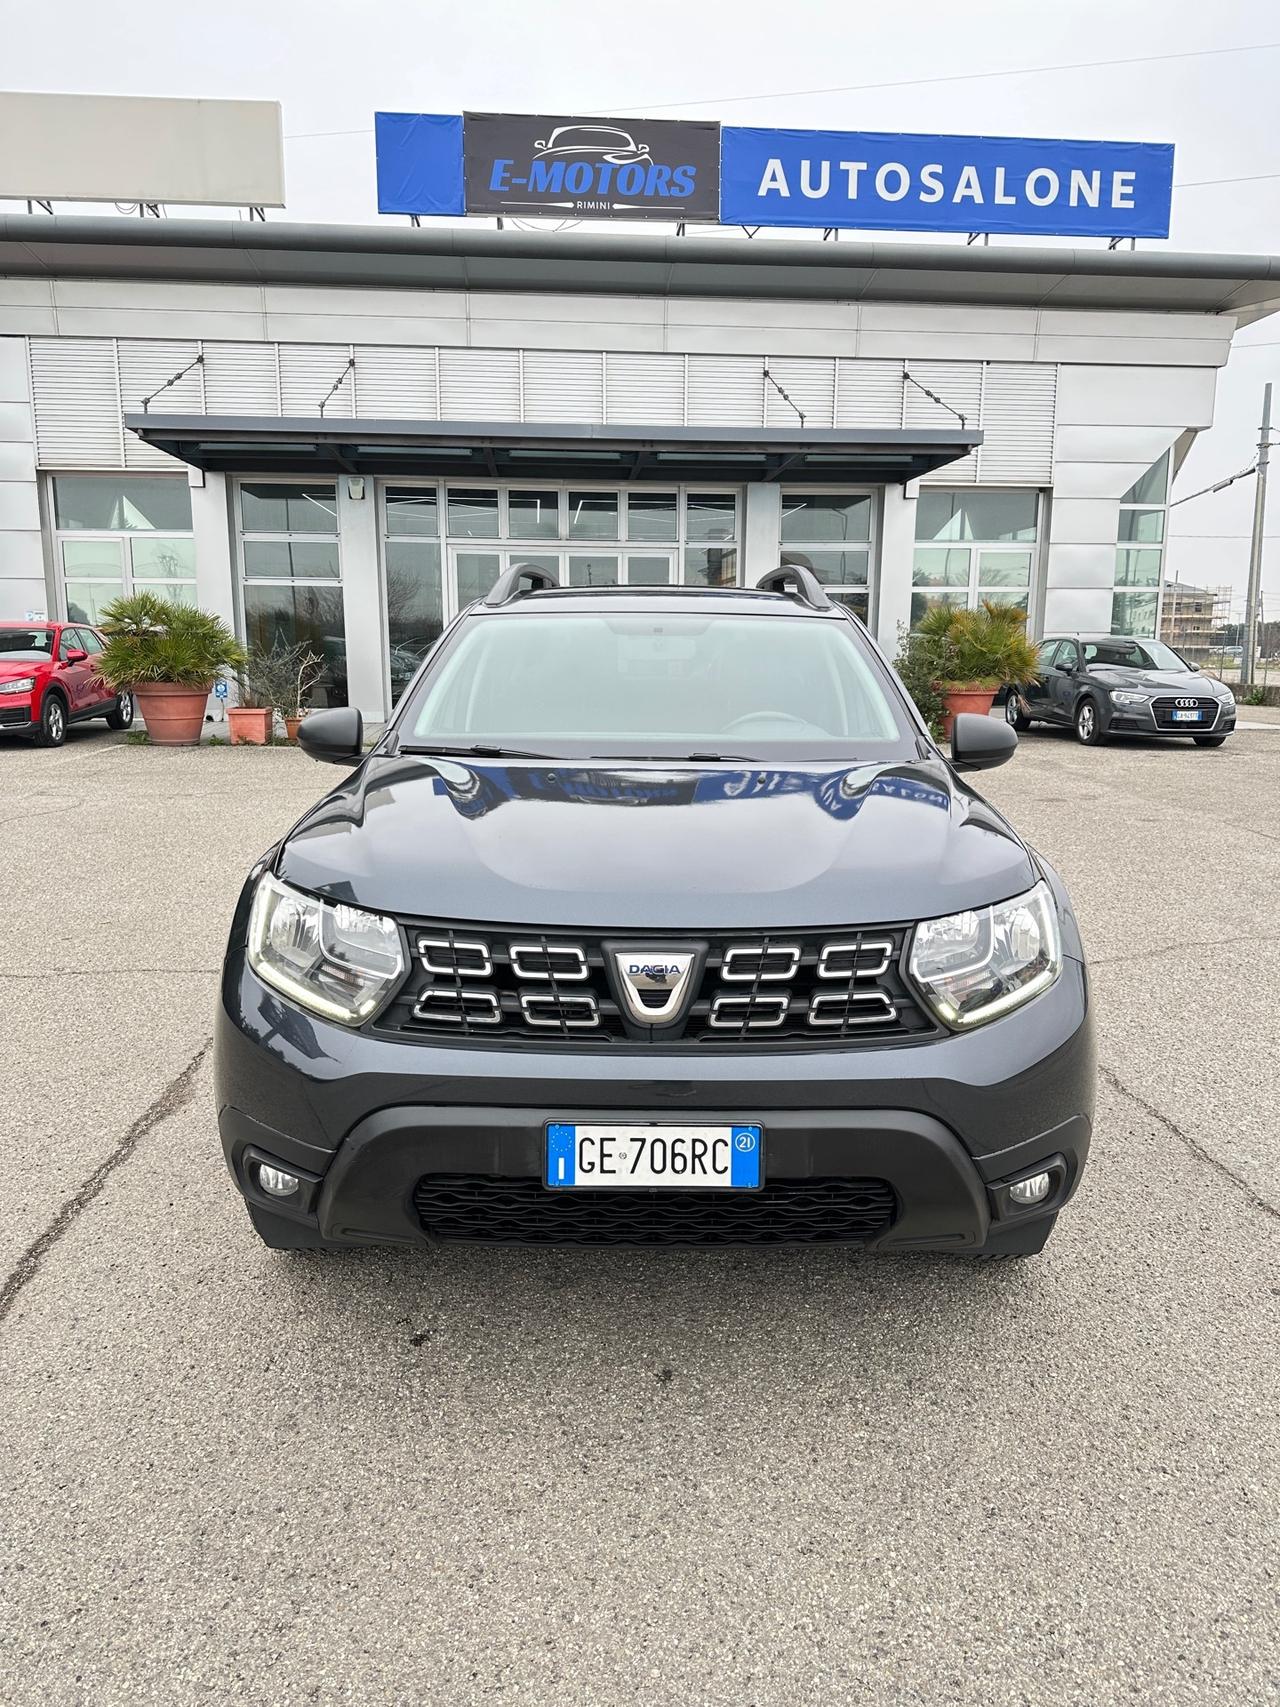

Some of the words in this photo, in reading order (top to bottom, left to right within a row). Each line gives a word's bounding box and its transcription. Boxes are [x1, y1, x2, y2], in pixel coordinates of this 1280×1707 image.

[489, 159, 697, 198] E-MOTORS
[757, 158, 1136, 209] AUTOSALONE
[576, 201, 611, 210] RIMINI
[629, 965, 681, 974] DACIA
[738, 1136, 751, 1149] 21
[578, 1137, 617, 1174] GE
[629, 1137, 729, 1175] 706RC
